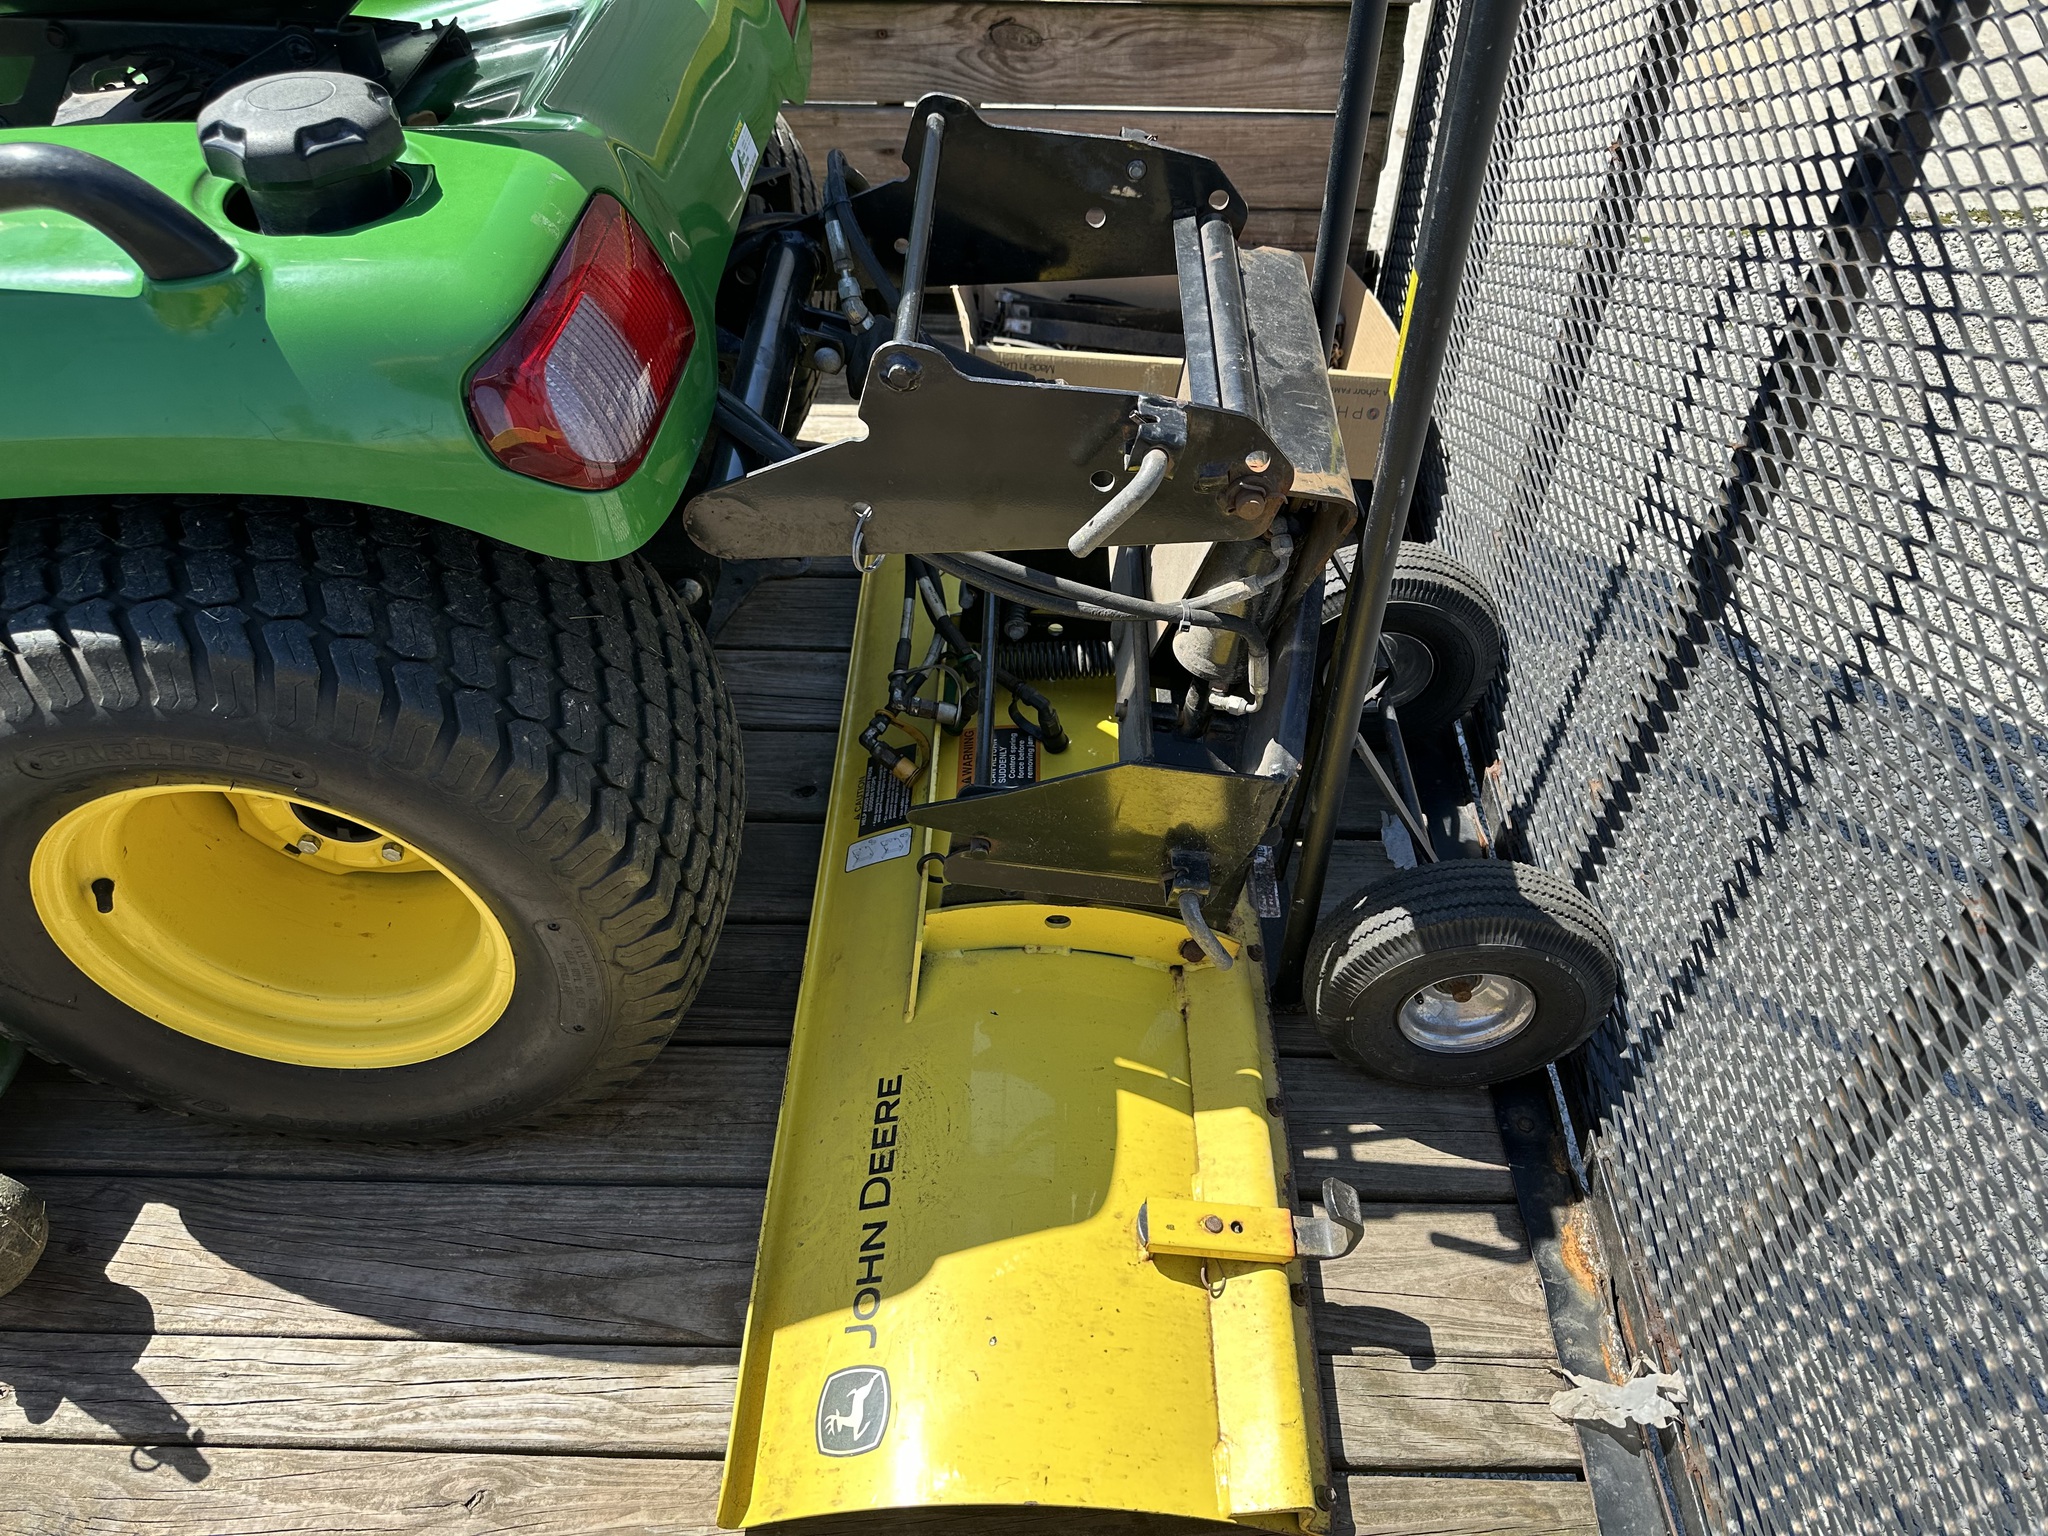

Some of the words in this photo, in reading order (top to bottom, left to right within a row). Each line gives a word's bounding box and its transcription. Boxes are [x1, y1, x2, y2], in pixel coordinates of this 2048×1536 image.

[1020, 362, 1027, 370] in
[1029, 363, 1055, 374] Made
[37, 742, 298, 779] CARLISLE
[962, 730, 974, 776] WARNING
[1010, 733, 1018, 753] spring
[998, 746, 1007, 783] SUDDENLY
[1008, 755, 1016, 779] Control
[1027, 748, 1035, 779] removing
[854, 776, 865, 812] CAUTION
[858, 1074, 903, 1211] DEERE
[844, 1220, 888, 1349] JOHN
